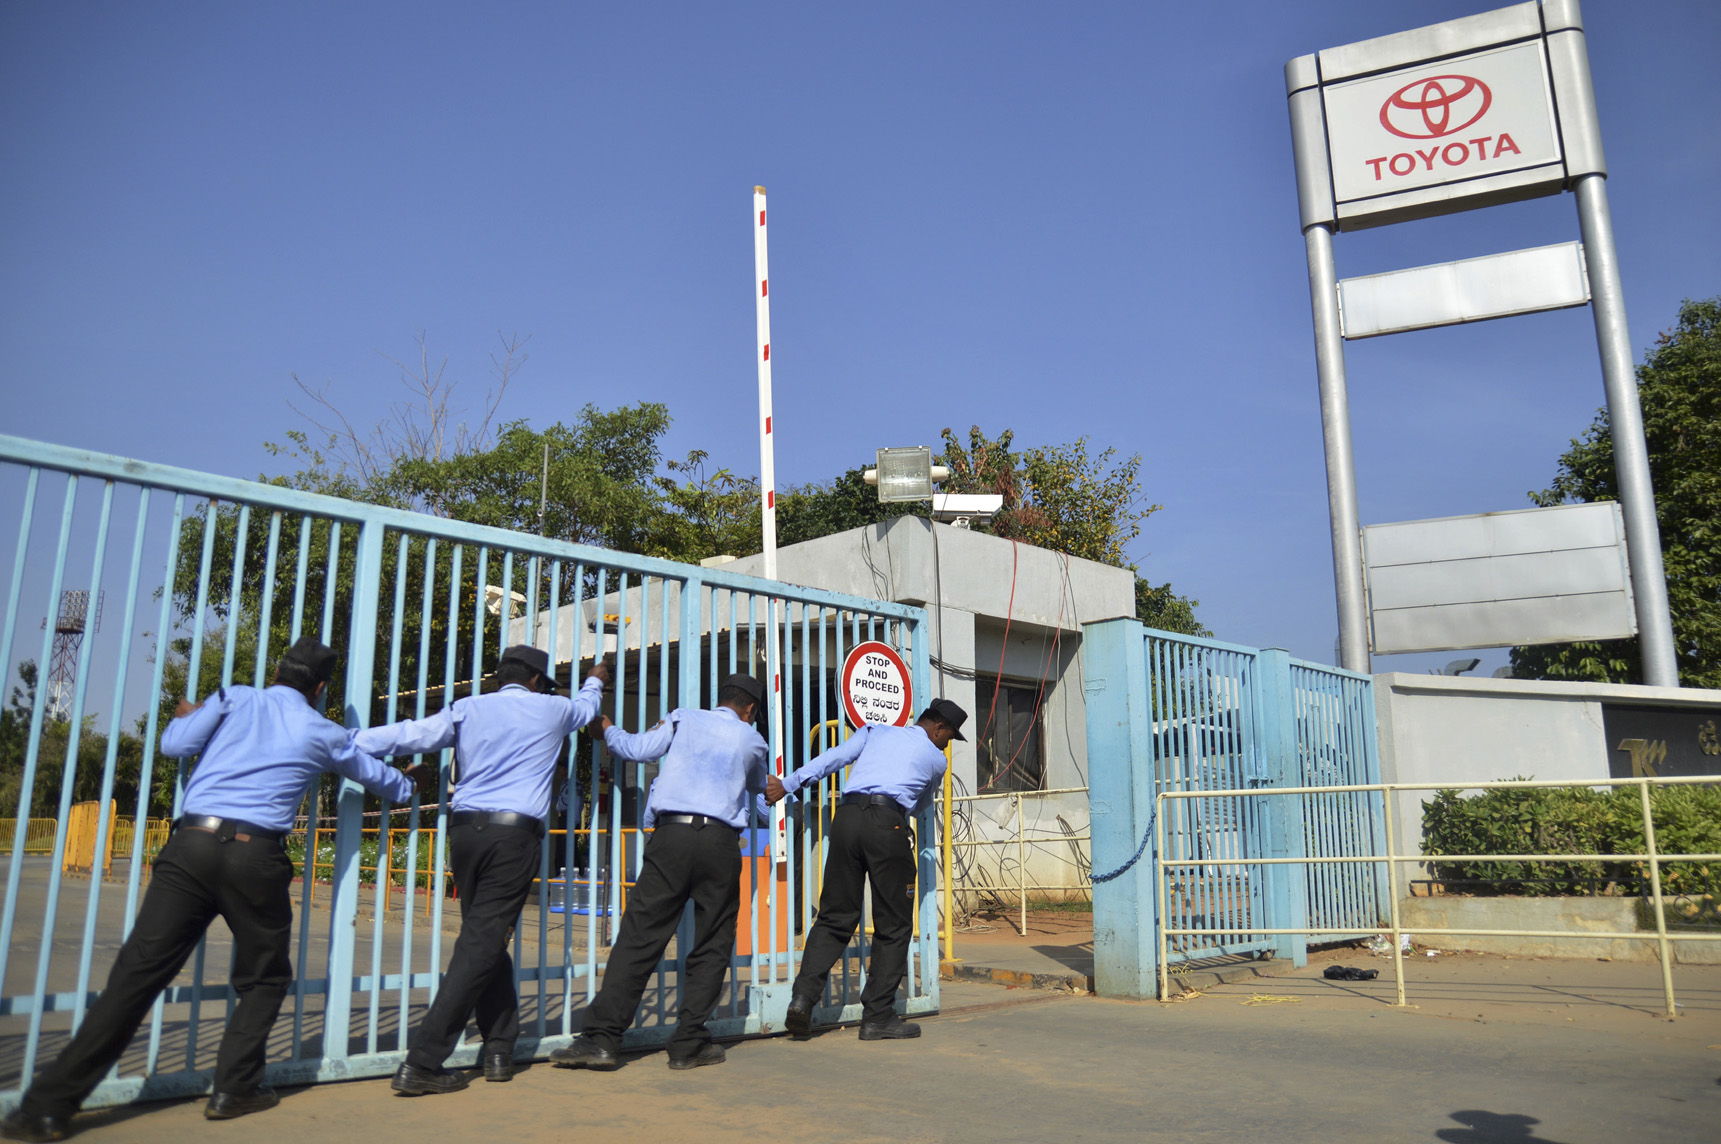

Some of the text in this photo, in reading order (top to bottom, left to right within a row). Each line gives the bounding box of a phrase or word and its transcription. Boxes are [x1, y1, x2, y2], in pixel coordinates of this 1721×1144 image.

[1365, 132, 1521, 181] TOYOTA
[865, 655, 890, 667] STOP
[868, 668, 887, 679] AND
[855, 678, 899, 693] PROCEED
